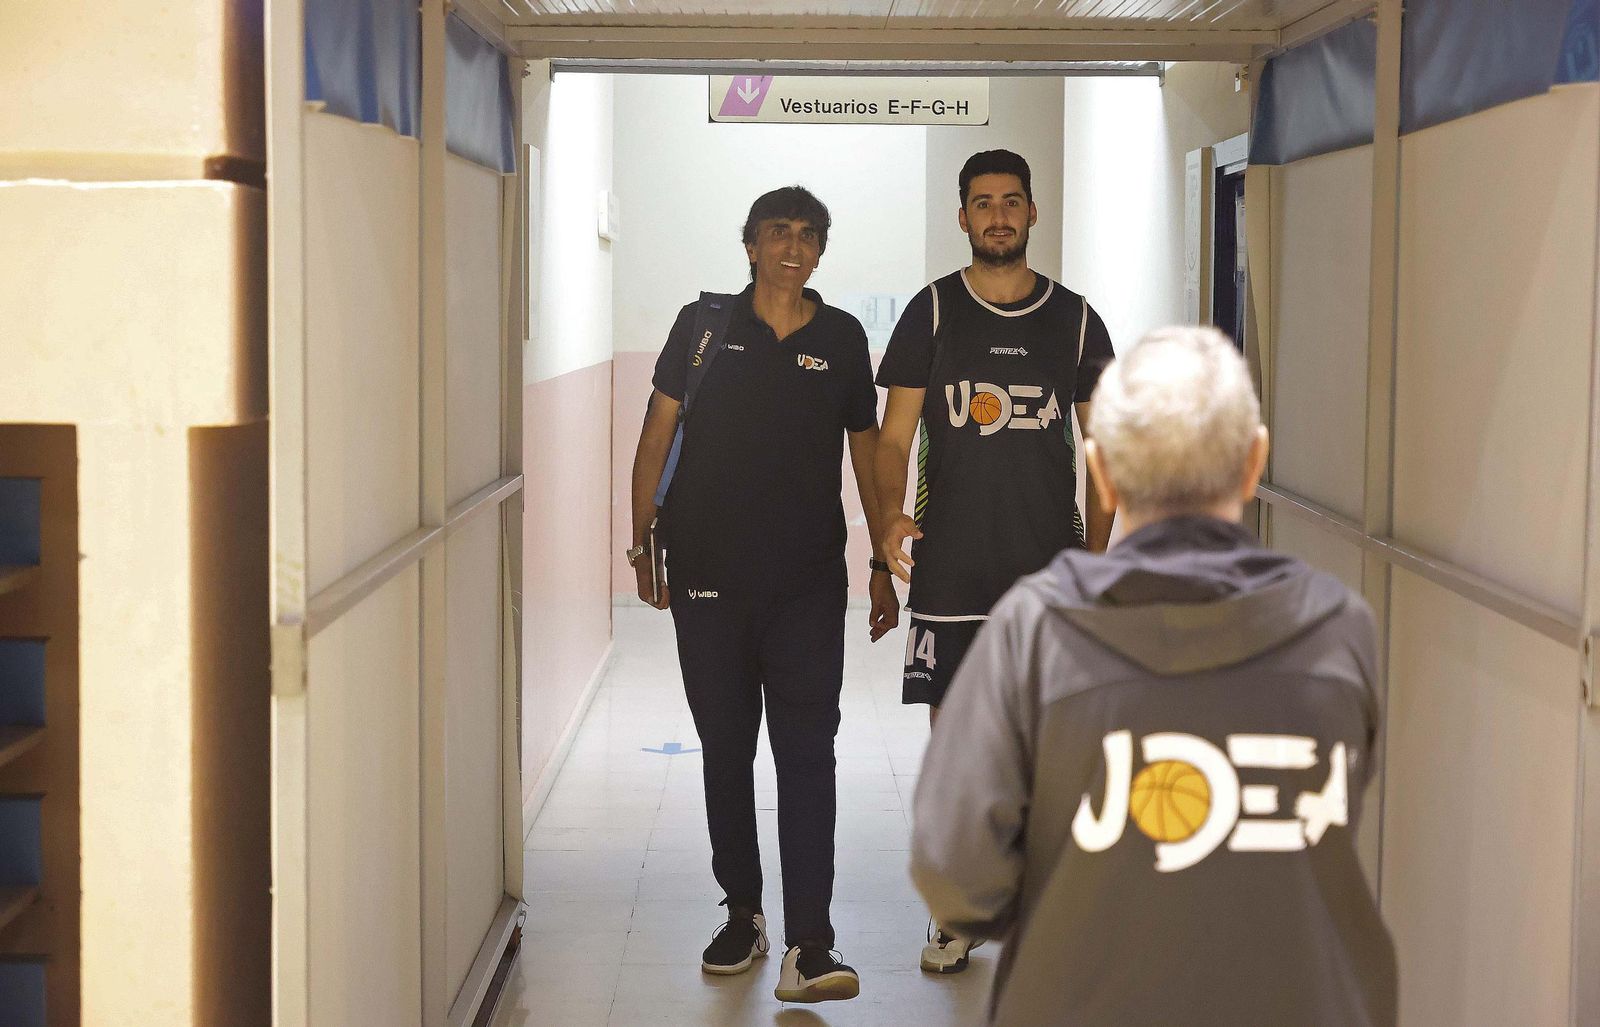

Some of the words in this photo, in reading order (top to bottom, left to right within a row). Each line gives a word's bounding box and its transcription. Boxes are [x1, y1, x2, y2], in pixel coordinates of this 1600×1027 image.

[780, 98, 878, 115] Vestuarios
[888, 99, 969, 116] E-F-G-H
[697, 330, 713, 355] WIBO
[727, 343, 745, 352] WIBO
[797, 353, 829, 371] UDEA
[945, 380, 1062, 436] UDEA
[905, 626, 937, 670] 14
